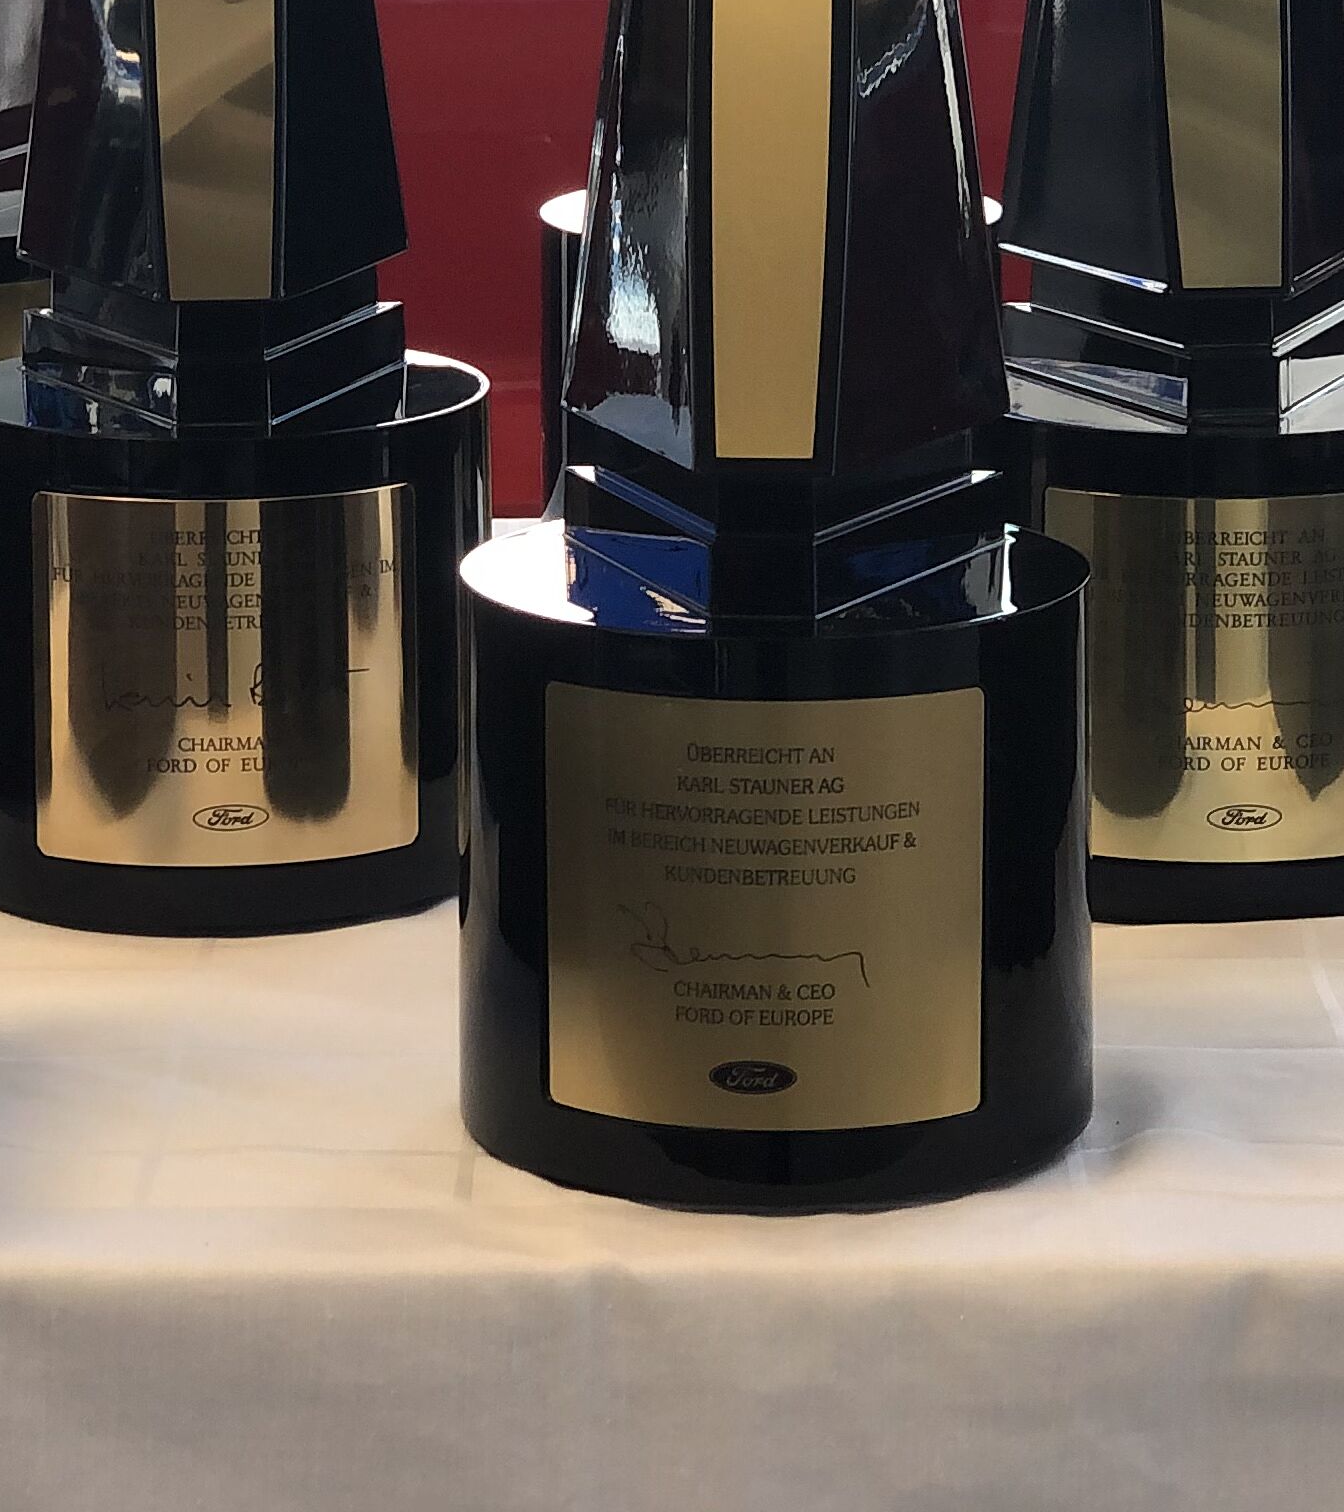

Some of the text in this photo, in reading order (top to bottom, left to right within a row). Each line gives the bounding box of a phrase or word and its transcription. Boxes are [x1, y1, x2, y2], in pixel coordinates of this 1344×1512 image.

[1217, 551, 1302, 566] STAUNER
[1272, 735, 1286, 750] &
[1296, 733, 1333, 749] CEO
[687, 742, 835, 765] ÜBERREICHT AN
[1220, 753, 1329, 771] OF EUROPE
[147, 758, 197, 773] FORD
[205, 758, 230, 773] OF
[676, 775, 845, 795] KARL STAUNER AG
[641, 801, 803, 826] HERVORRAGENDE
[808, 801, 921, 825] LEISTUNGEN
[608, 828, 917, 856] IM BEREICH NEUWAGENVERKAUF &
[664, 864, 857, 887] KUNDENBETREUUNG
[673, 979, 836, 1001] CHAIRMAN & CEO
[674, 1005, 835, 1027] FORD OF EUROPE
